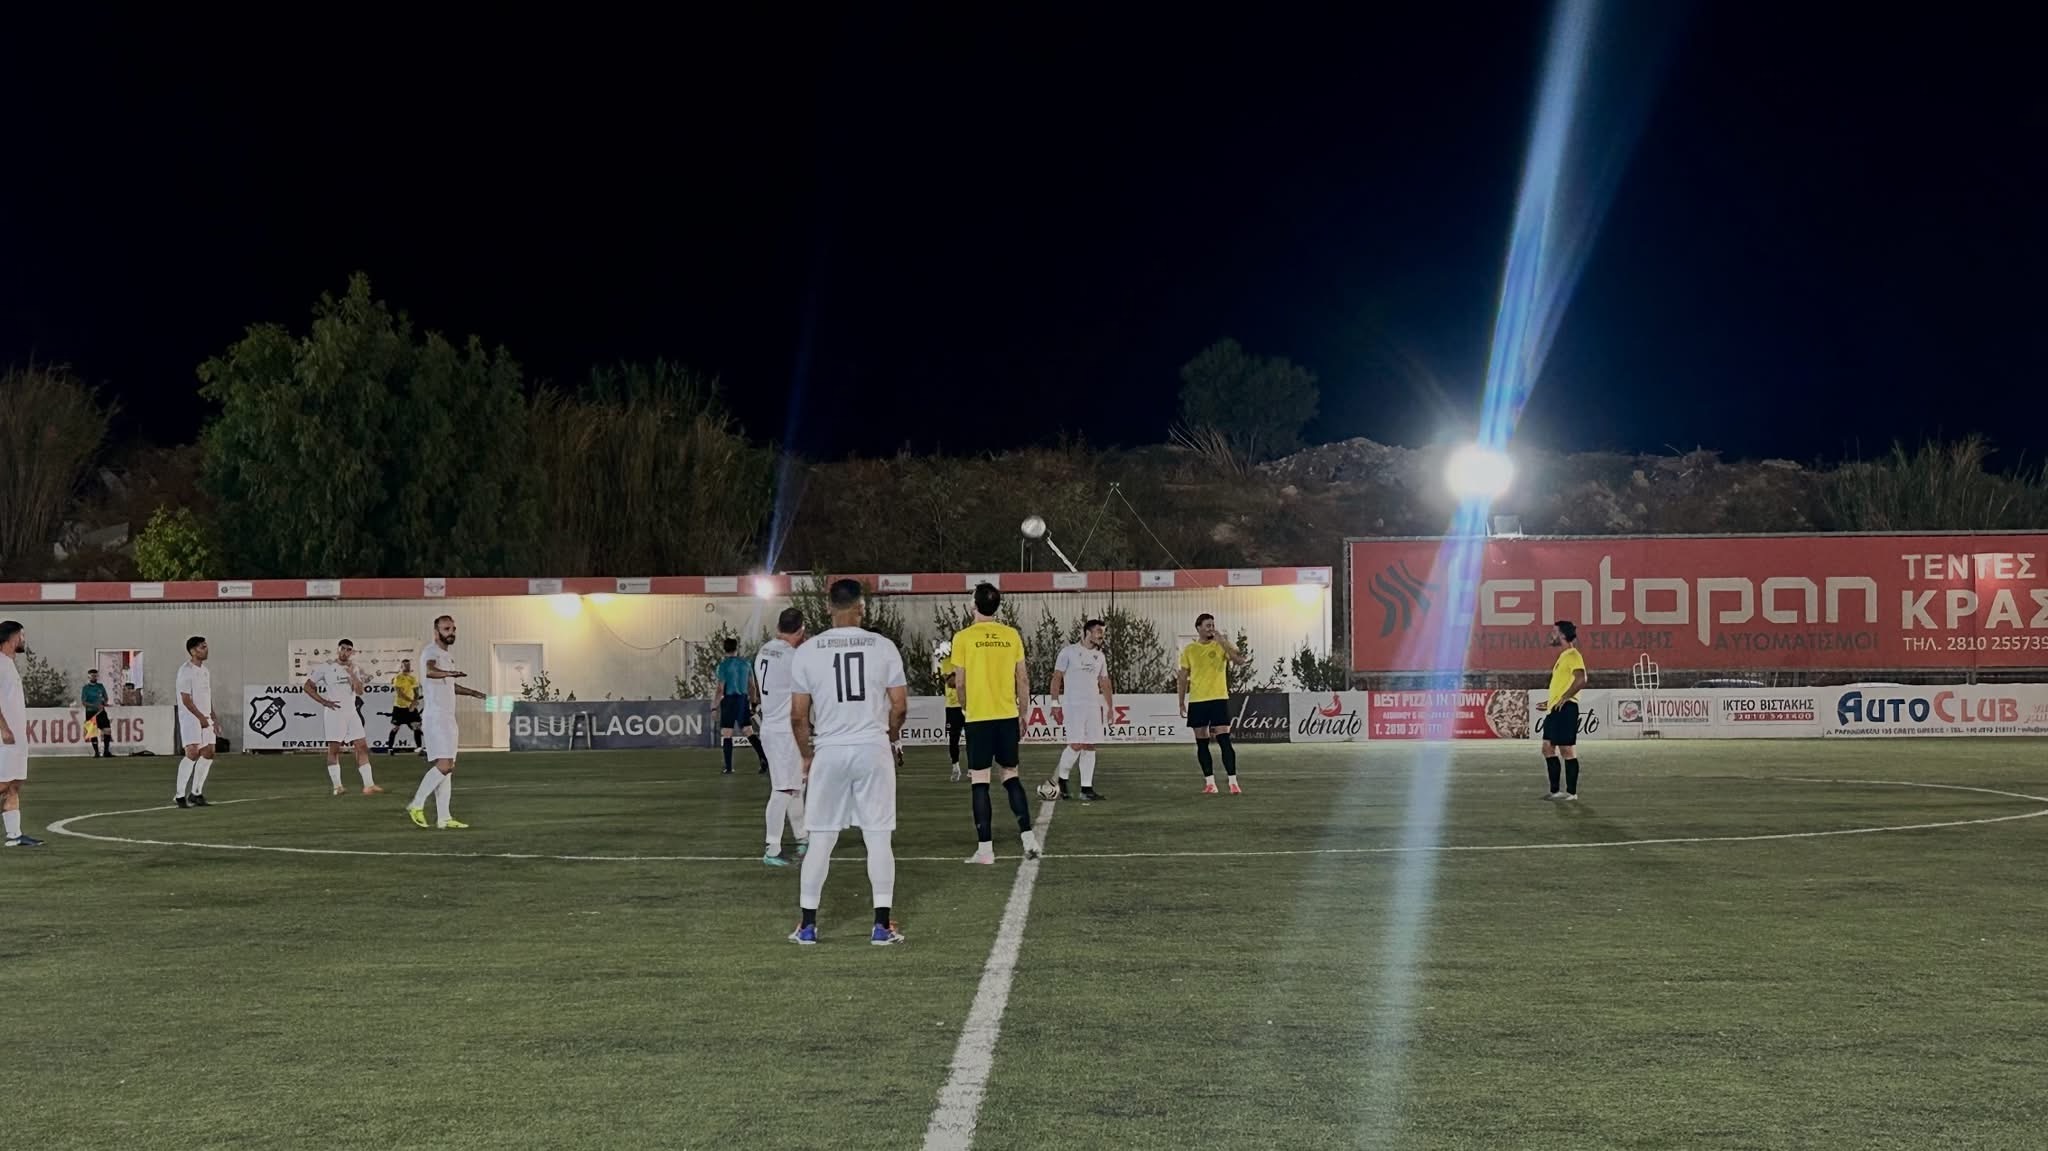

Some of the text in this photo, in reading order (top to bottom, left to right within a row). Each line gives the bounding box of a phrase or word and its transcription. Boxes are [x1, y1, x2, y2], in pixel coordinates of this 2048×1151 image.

[1901, 552, 2037, 580] ΤΕΝΤΕΣ
[1903, 637, 1942, 651] ΤΗΛ.
[1947, 637, 1987, 651] 2810
[832, 651, 866, 703] 10
[1723, 699, 1814, 711] ΙΚΤΕΟ ΒΙΣΤΑΚΗΣ
[592, 714, 702, 736] LAGOON
[1298, 706, 1362, 736] donato
